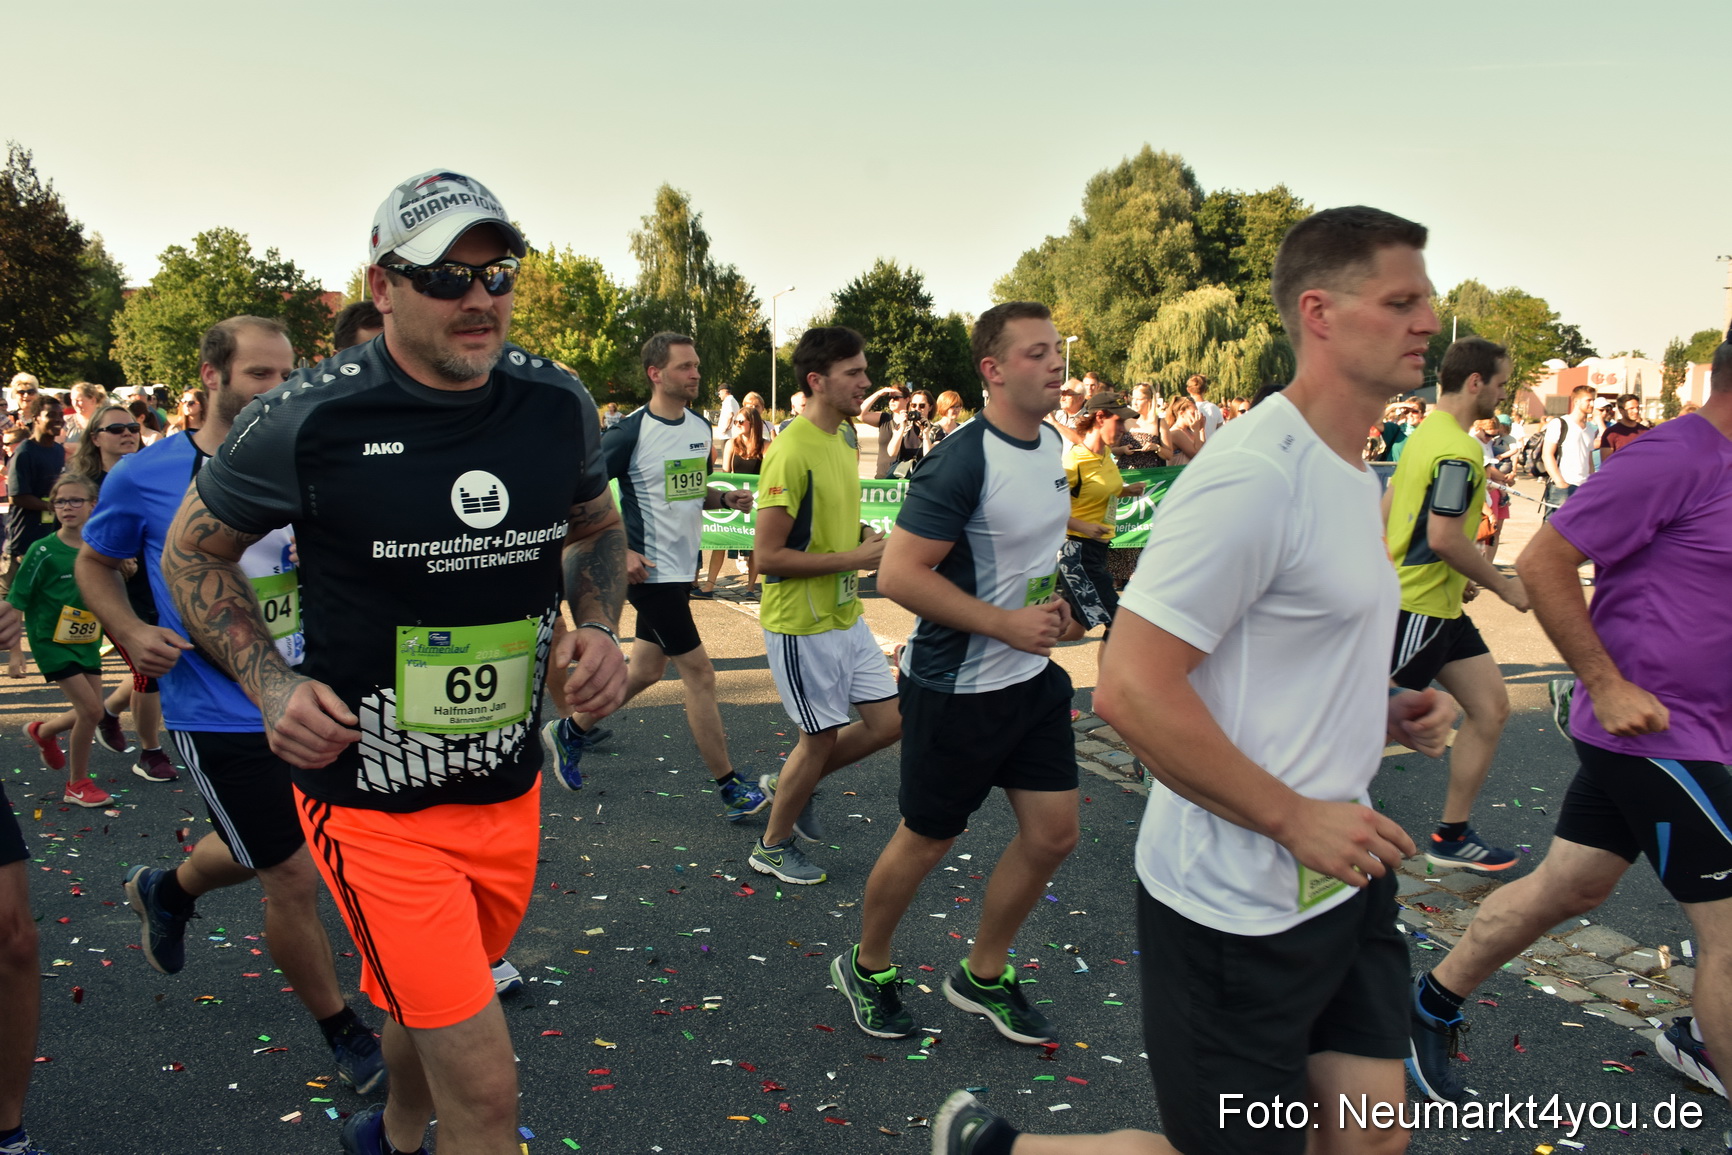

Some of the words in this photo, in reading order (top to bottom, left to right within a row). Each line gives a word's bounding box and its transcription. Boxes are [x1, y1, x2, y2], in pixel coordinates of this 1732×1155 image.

[400, 192, 505, 230] CHAMPIONS
[1591, 372, 1618, 385] G6
[362, 441, 405, 456] JAKO
[671, 471, 703, 489] 1919
[426, 547, 541, 574] SCHOTTERWERKE
[69, 621, 97, 635] 589
[446, 664, 498, 704] 69
[434, 706, 488, 716] Halfmann
[489, 702, 506, 712] Jan
